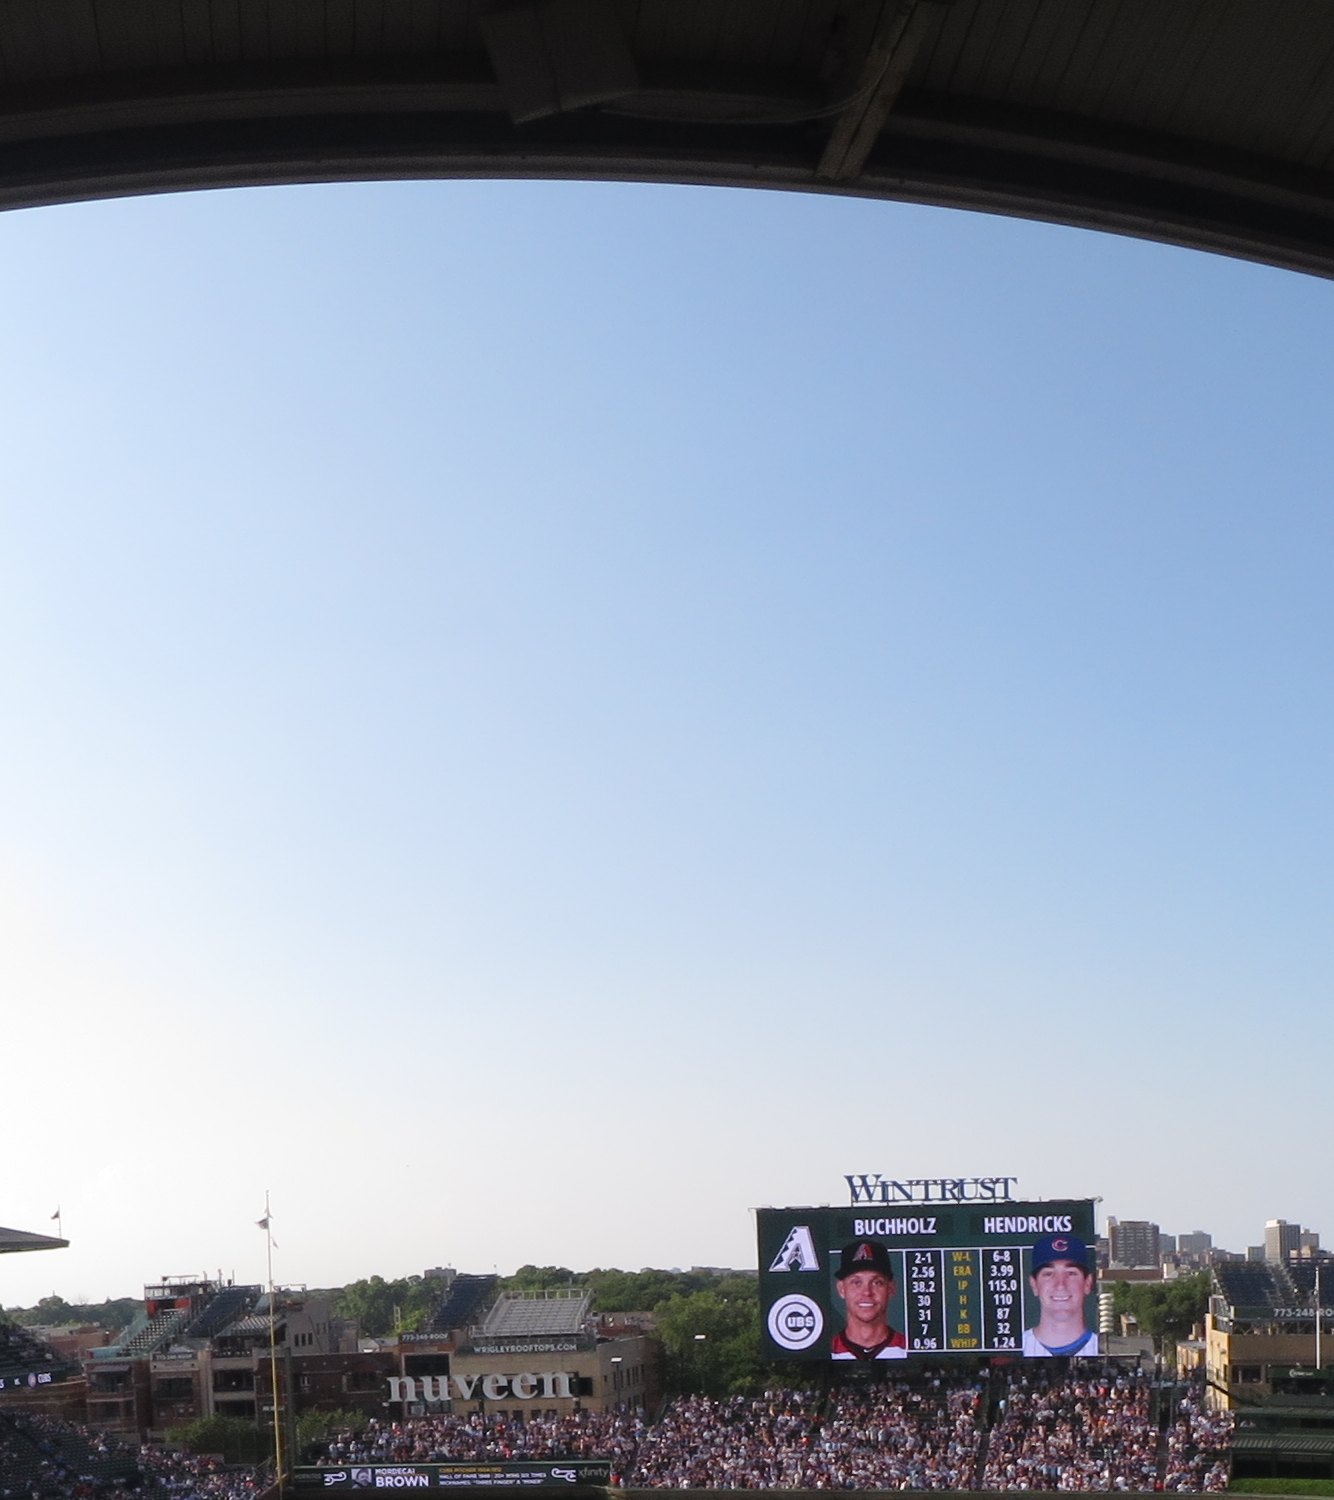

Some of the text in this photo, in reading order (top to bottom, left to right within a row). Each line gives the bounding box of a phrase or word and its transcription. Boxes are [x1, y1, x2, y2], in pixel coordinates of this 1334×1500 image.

[854, 1215, 1072, 1236] BUCHHOLZ HENDRICKS
[914, 1250, 1011, 1264] 2-1 W-L 6-8
[911, 1265, 1014, 1279] 2.56 ERA 3.99
[912, 1279, 1017, 1293] 38.2 IP 115.0
[917, 1293, 1013, 1307] 30 H 110
[918, 1308, 1010, 1321] 31 K 87
[921, 1322, 1011, 1335] 7 BB 32
[913, 1337, 1016, 1350] 0.96 WHIP 1.24
[386, 1371, 575, 1403] nuveen
[374, 1467, 416, 1476] MORDECAI
[577, 1466, 609, 1478] xfinity
[374, 1475, 430, 1489] BROWN
